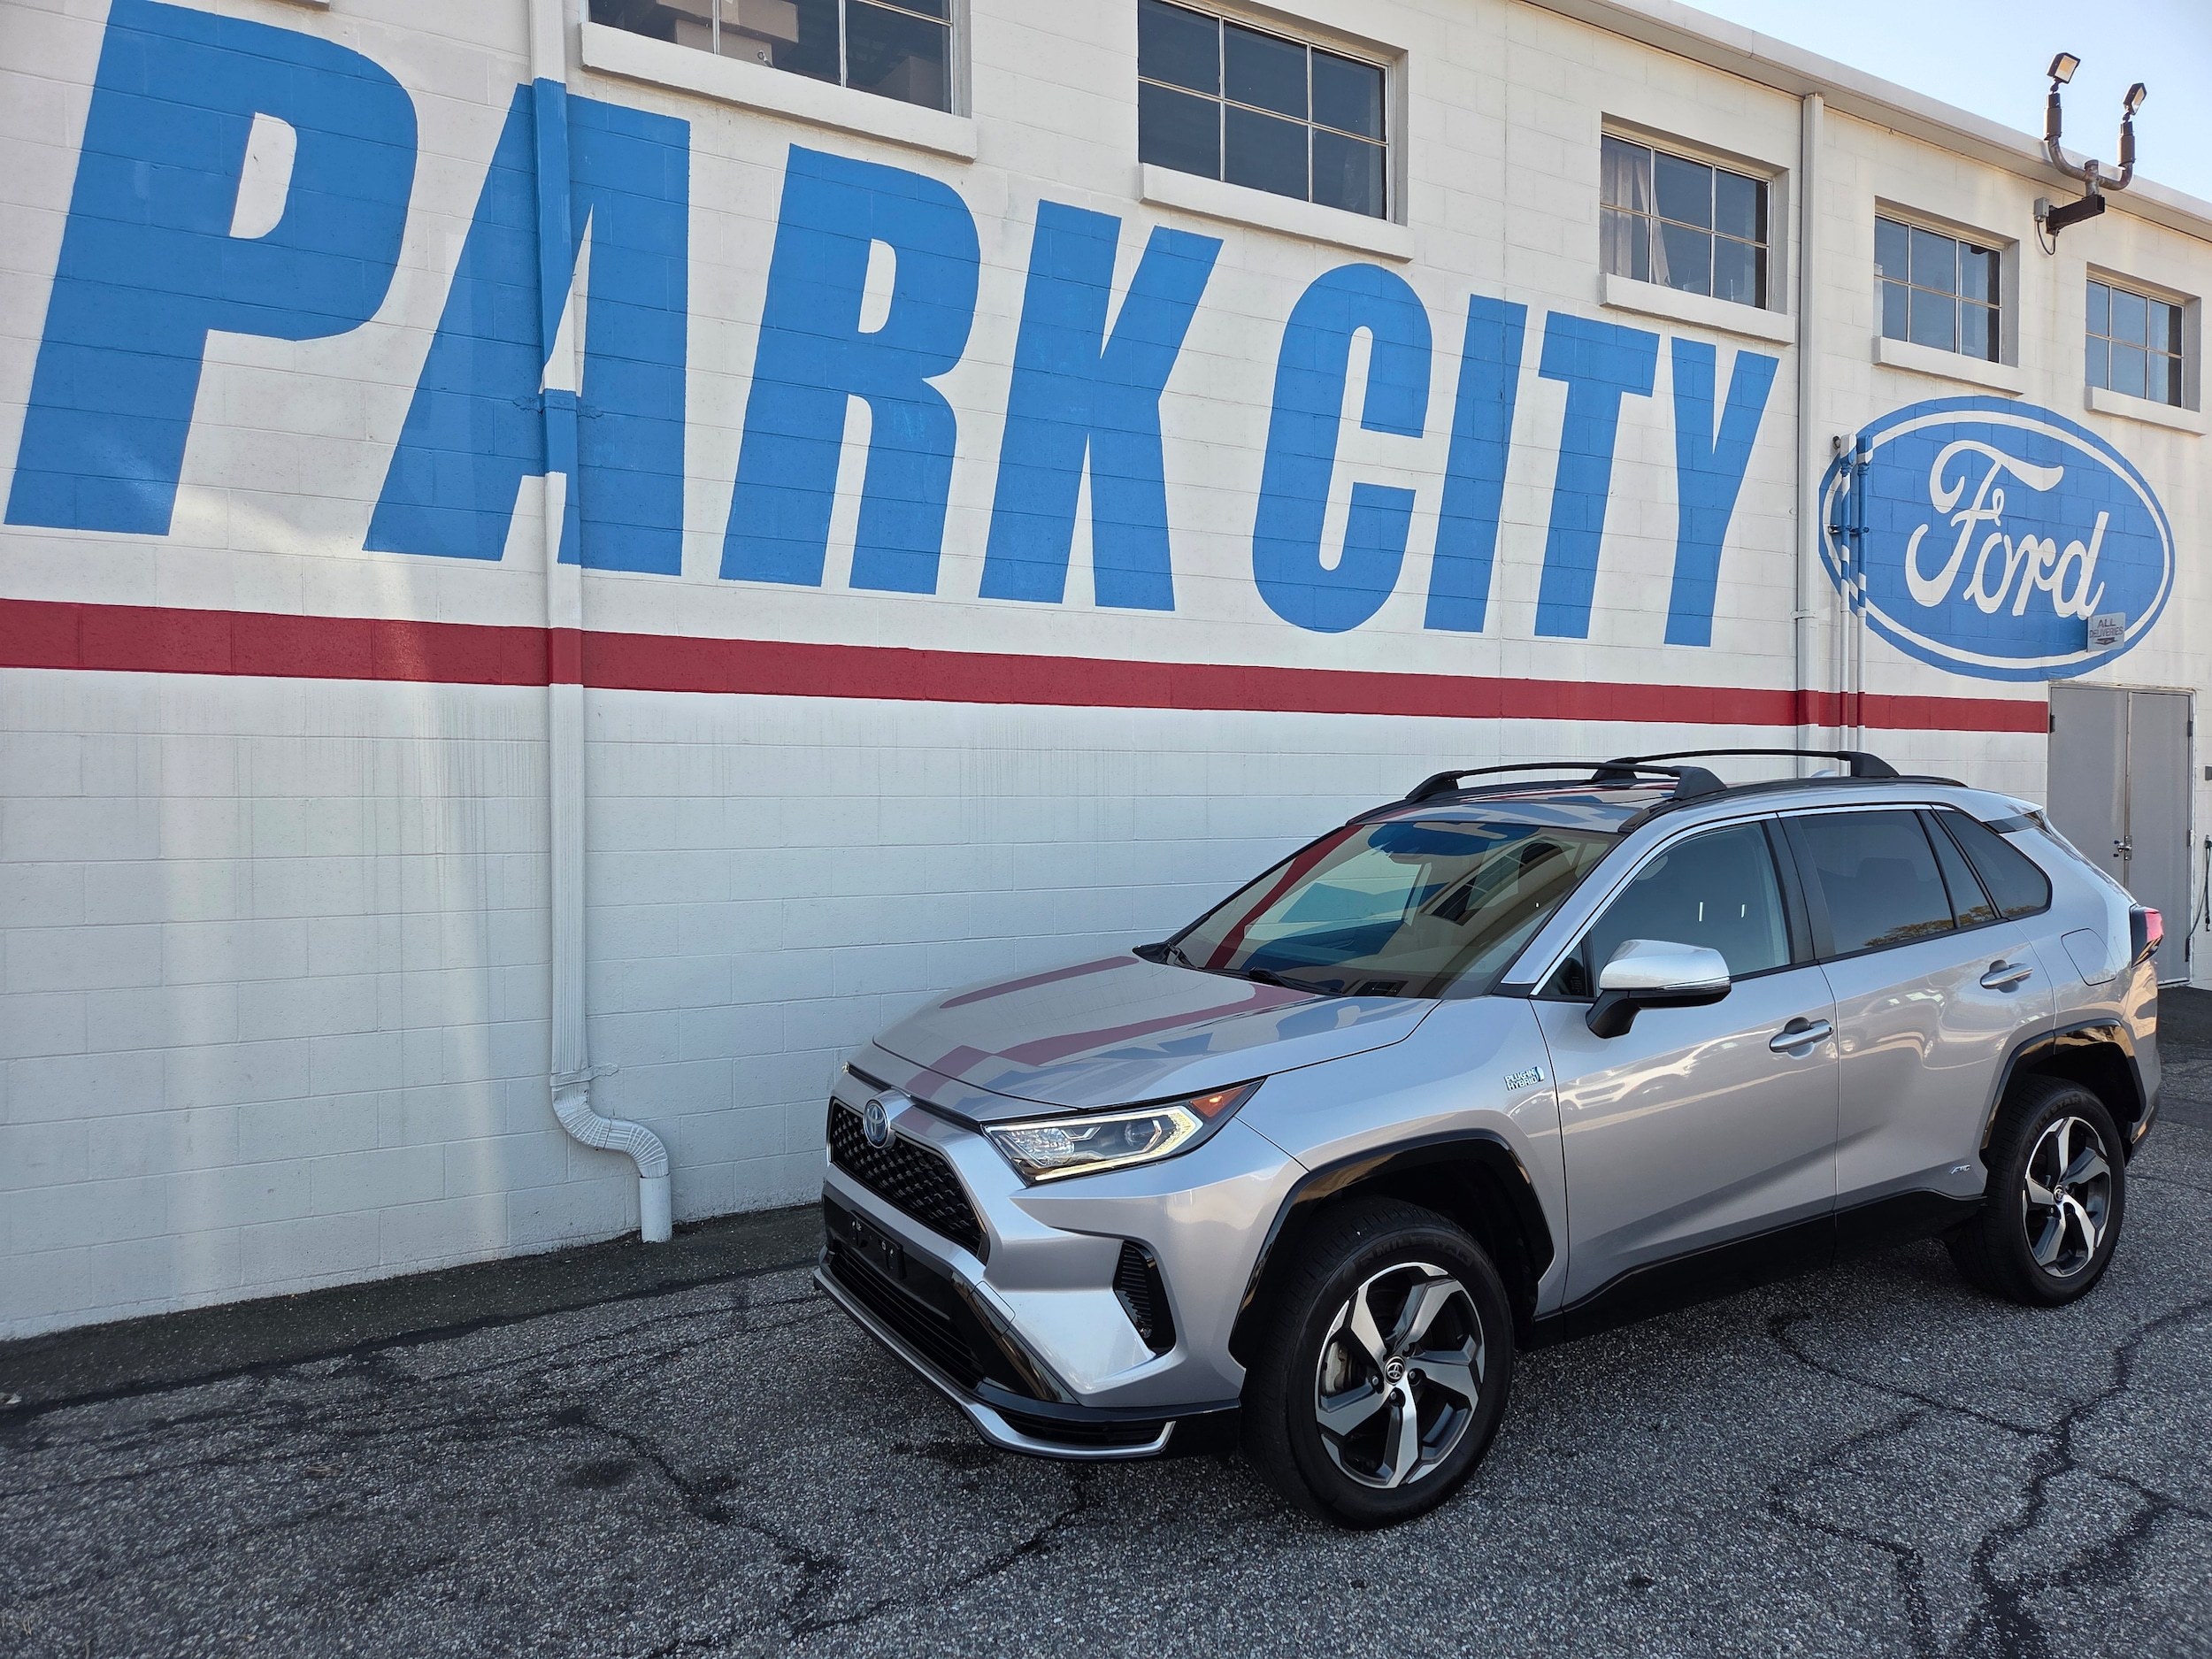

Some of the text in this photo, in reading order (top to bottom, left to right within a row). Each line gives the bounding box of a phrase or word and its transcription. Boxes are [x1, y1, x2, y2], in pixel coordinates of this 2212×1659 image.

[4, 0, 1779, 648] PARK CITY
[1905, 440, 2109, 620] Ford
[2097, 618, 2116, 628] ALL
[2089, 626, 2124, 638] DELIVERIES
[1504, 1068, 1535, 1082] PLUG-IN
[1507, 1076, 1537, 1091] HYBRID
